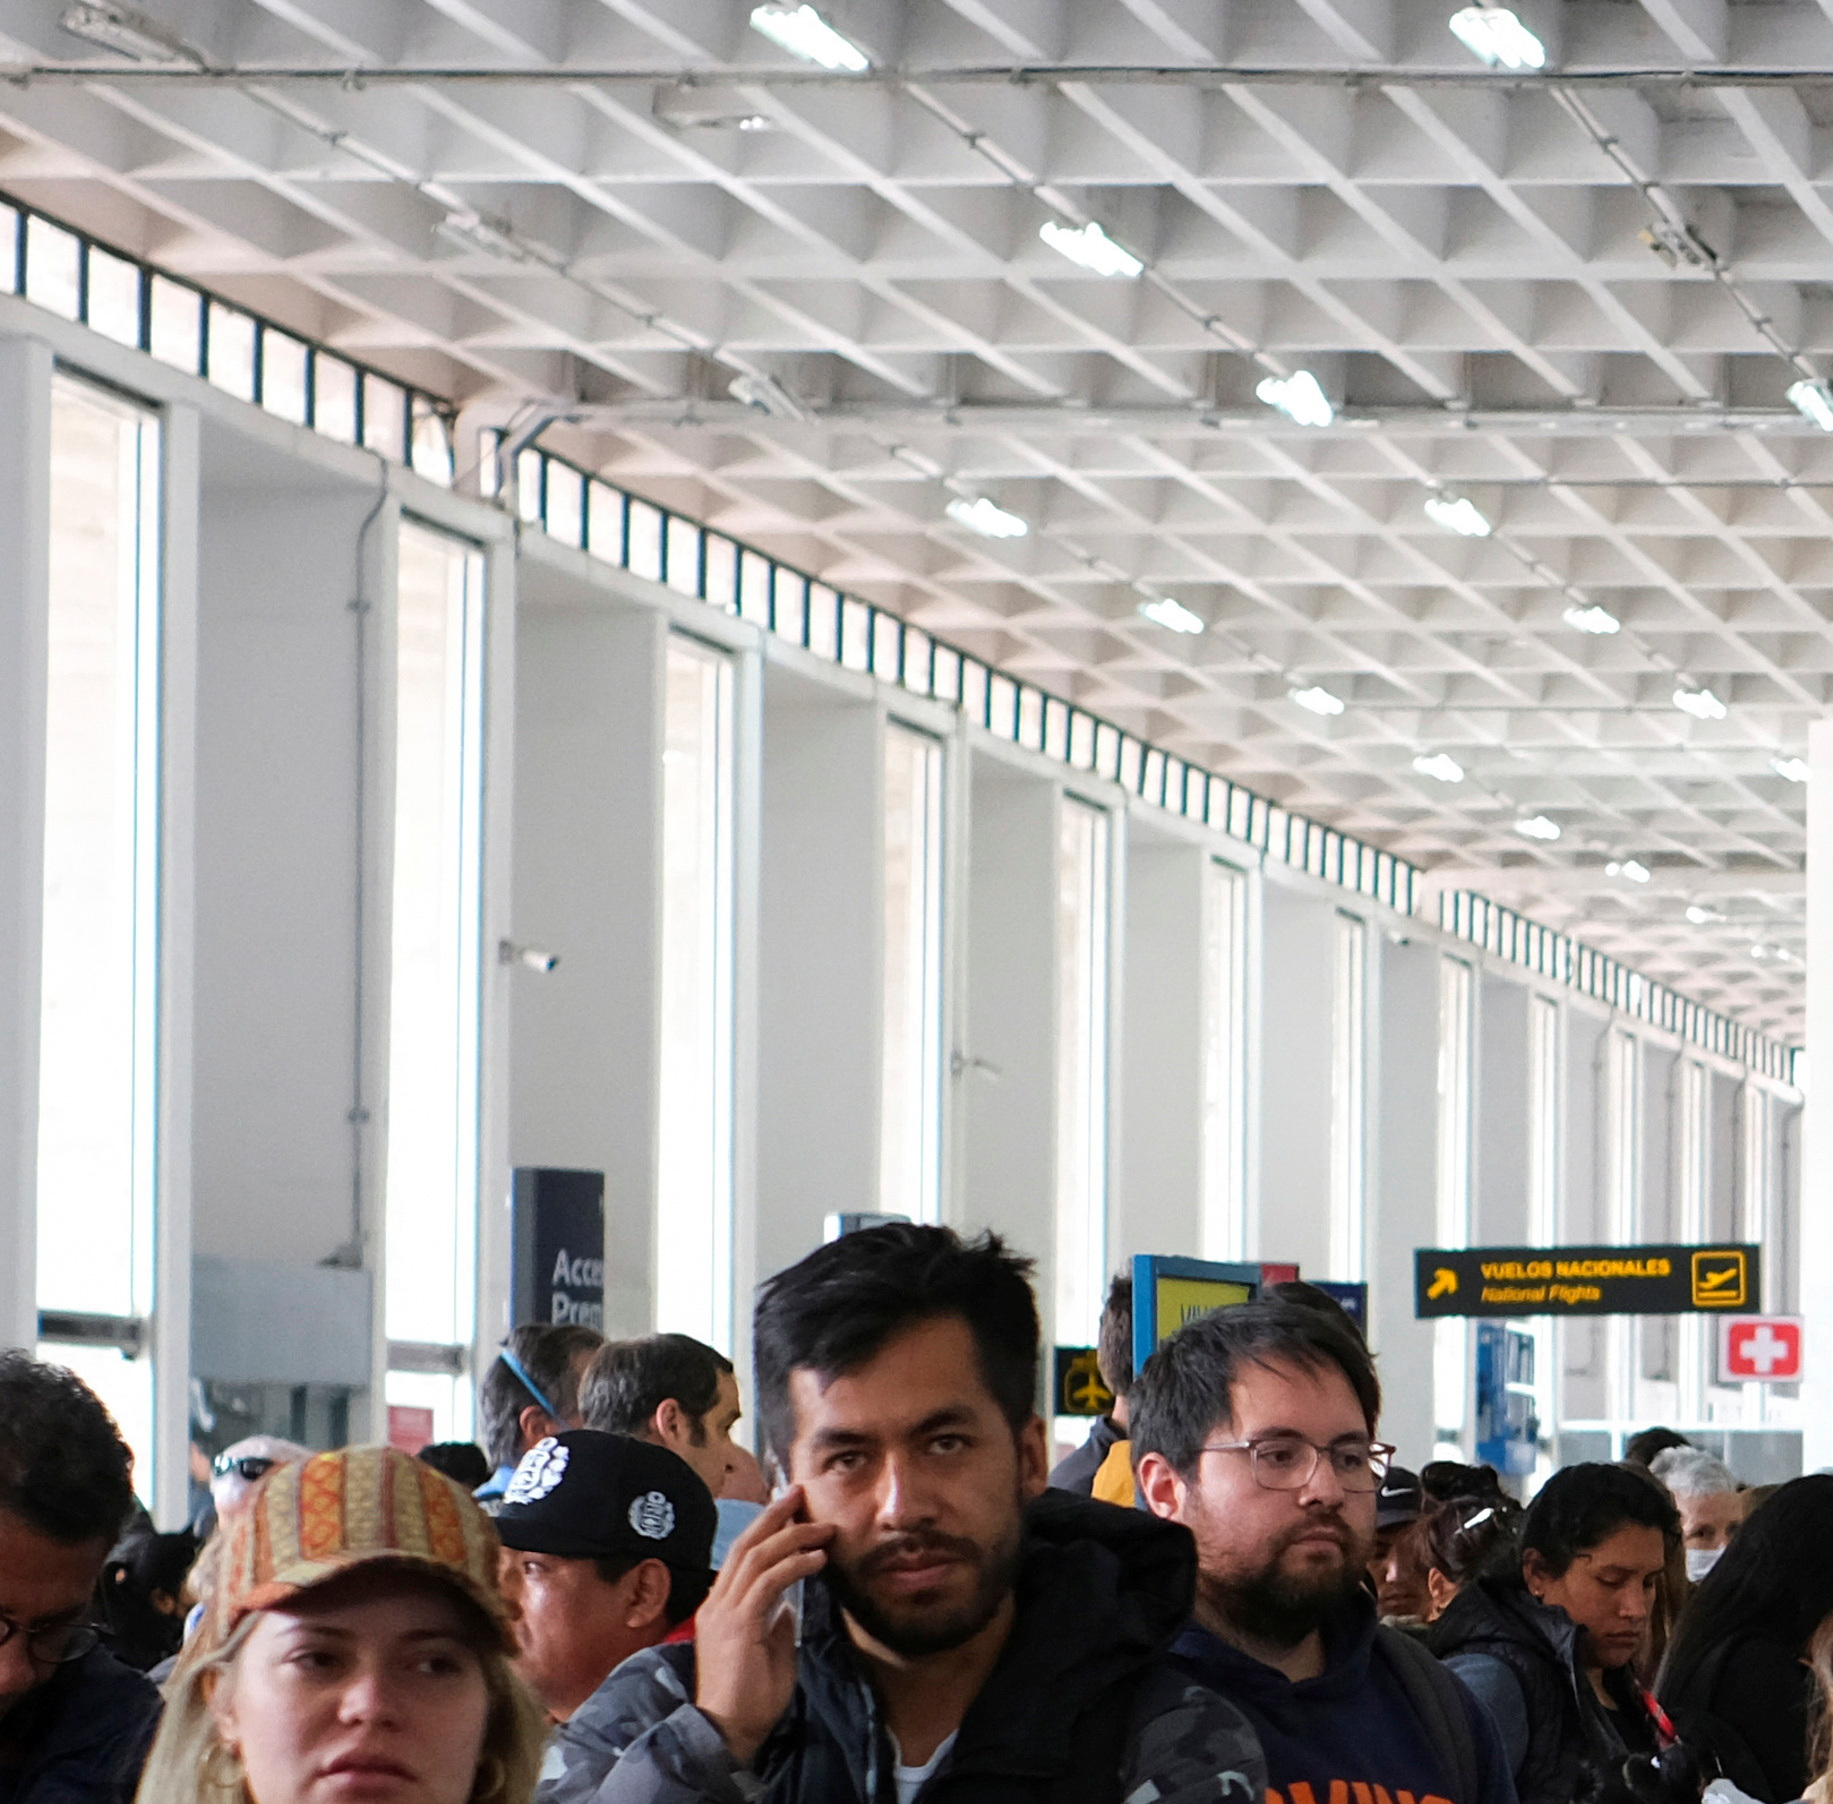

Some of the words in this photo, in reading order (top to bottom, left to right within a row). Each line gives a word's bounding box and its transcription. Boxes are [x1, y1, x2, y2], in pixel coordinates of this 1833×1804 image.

[1481, 1261, 1553, 1280] VUELOS
[1556, 1258, 1671, 1277] NACIONALES
[1481, 1286, 1547, 1303] National
[1548, 1284, 1602, 1305] Flights
